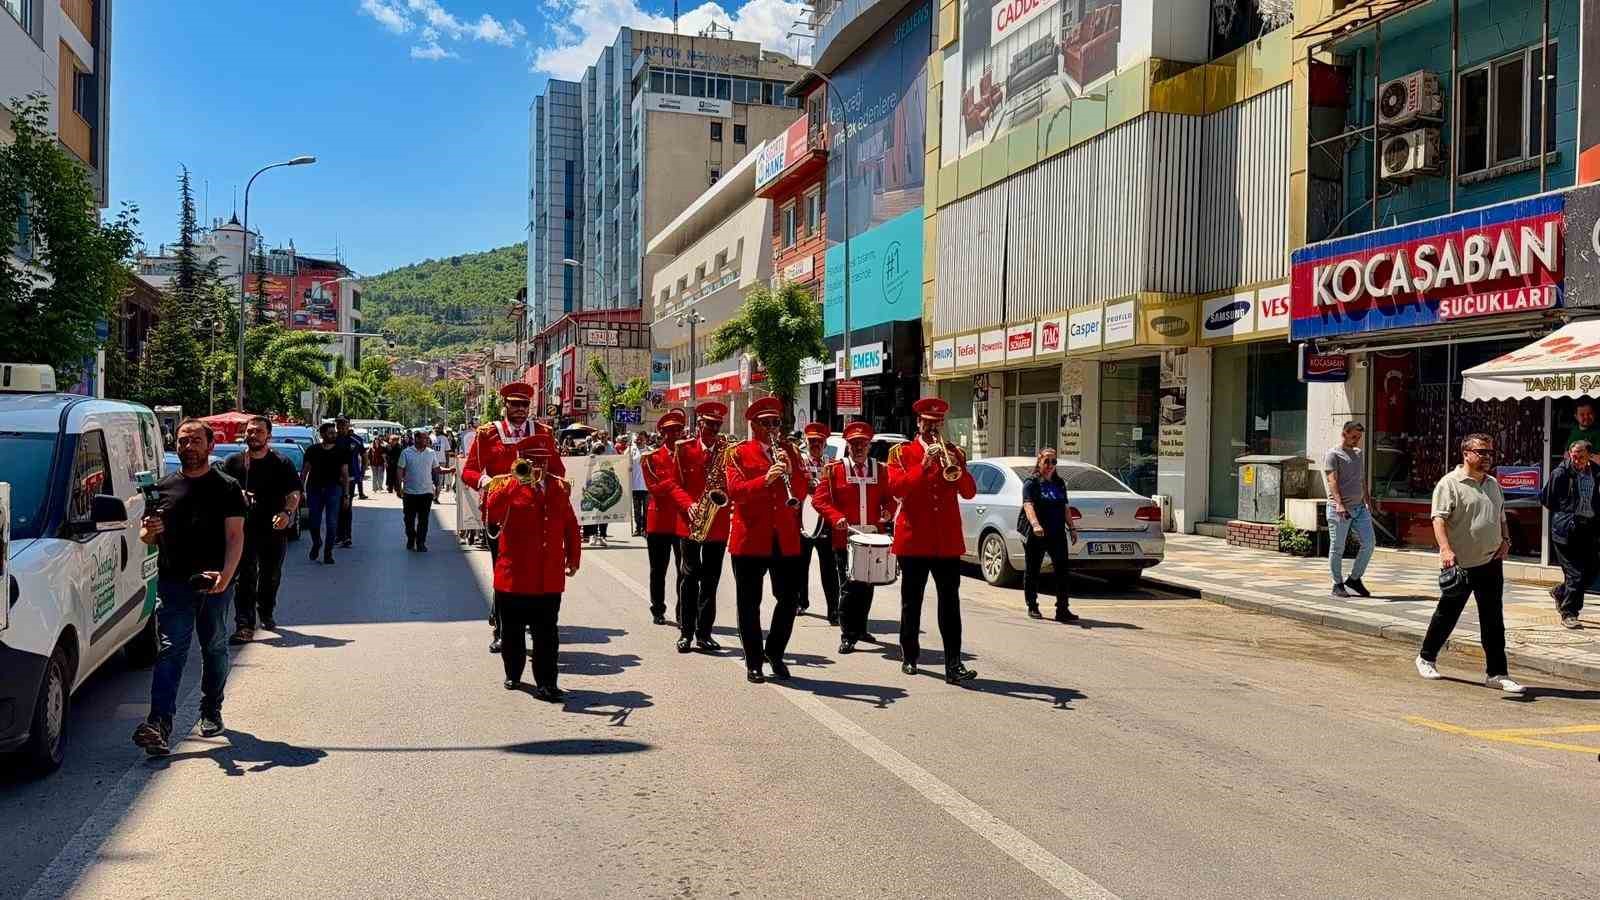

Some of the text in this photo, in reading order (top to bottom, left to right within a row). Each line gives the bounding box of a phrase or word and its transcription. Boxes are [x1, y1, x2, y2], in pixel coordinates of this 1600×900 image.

[997, 0, 1040, 31] CADD
[1312, 221, 1558, 308] KOCAŞABAN
[1440, 287, 1551, 317] SUCUKLARI
[1210, 308, 1245, 323] SAMSUNG
[1071, 320, 1100, 338] Casper
[852, 349, 880, 370] EMENS
[934, 345, 953, 361] PHILIPS
[958, 344, 977, 358] Tefal
[1523, 372, 1576, 392] TARİHİ
